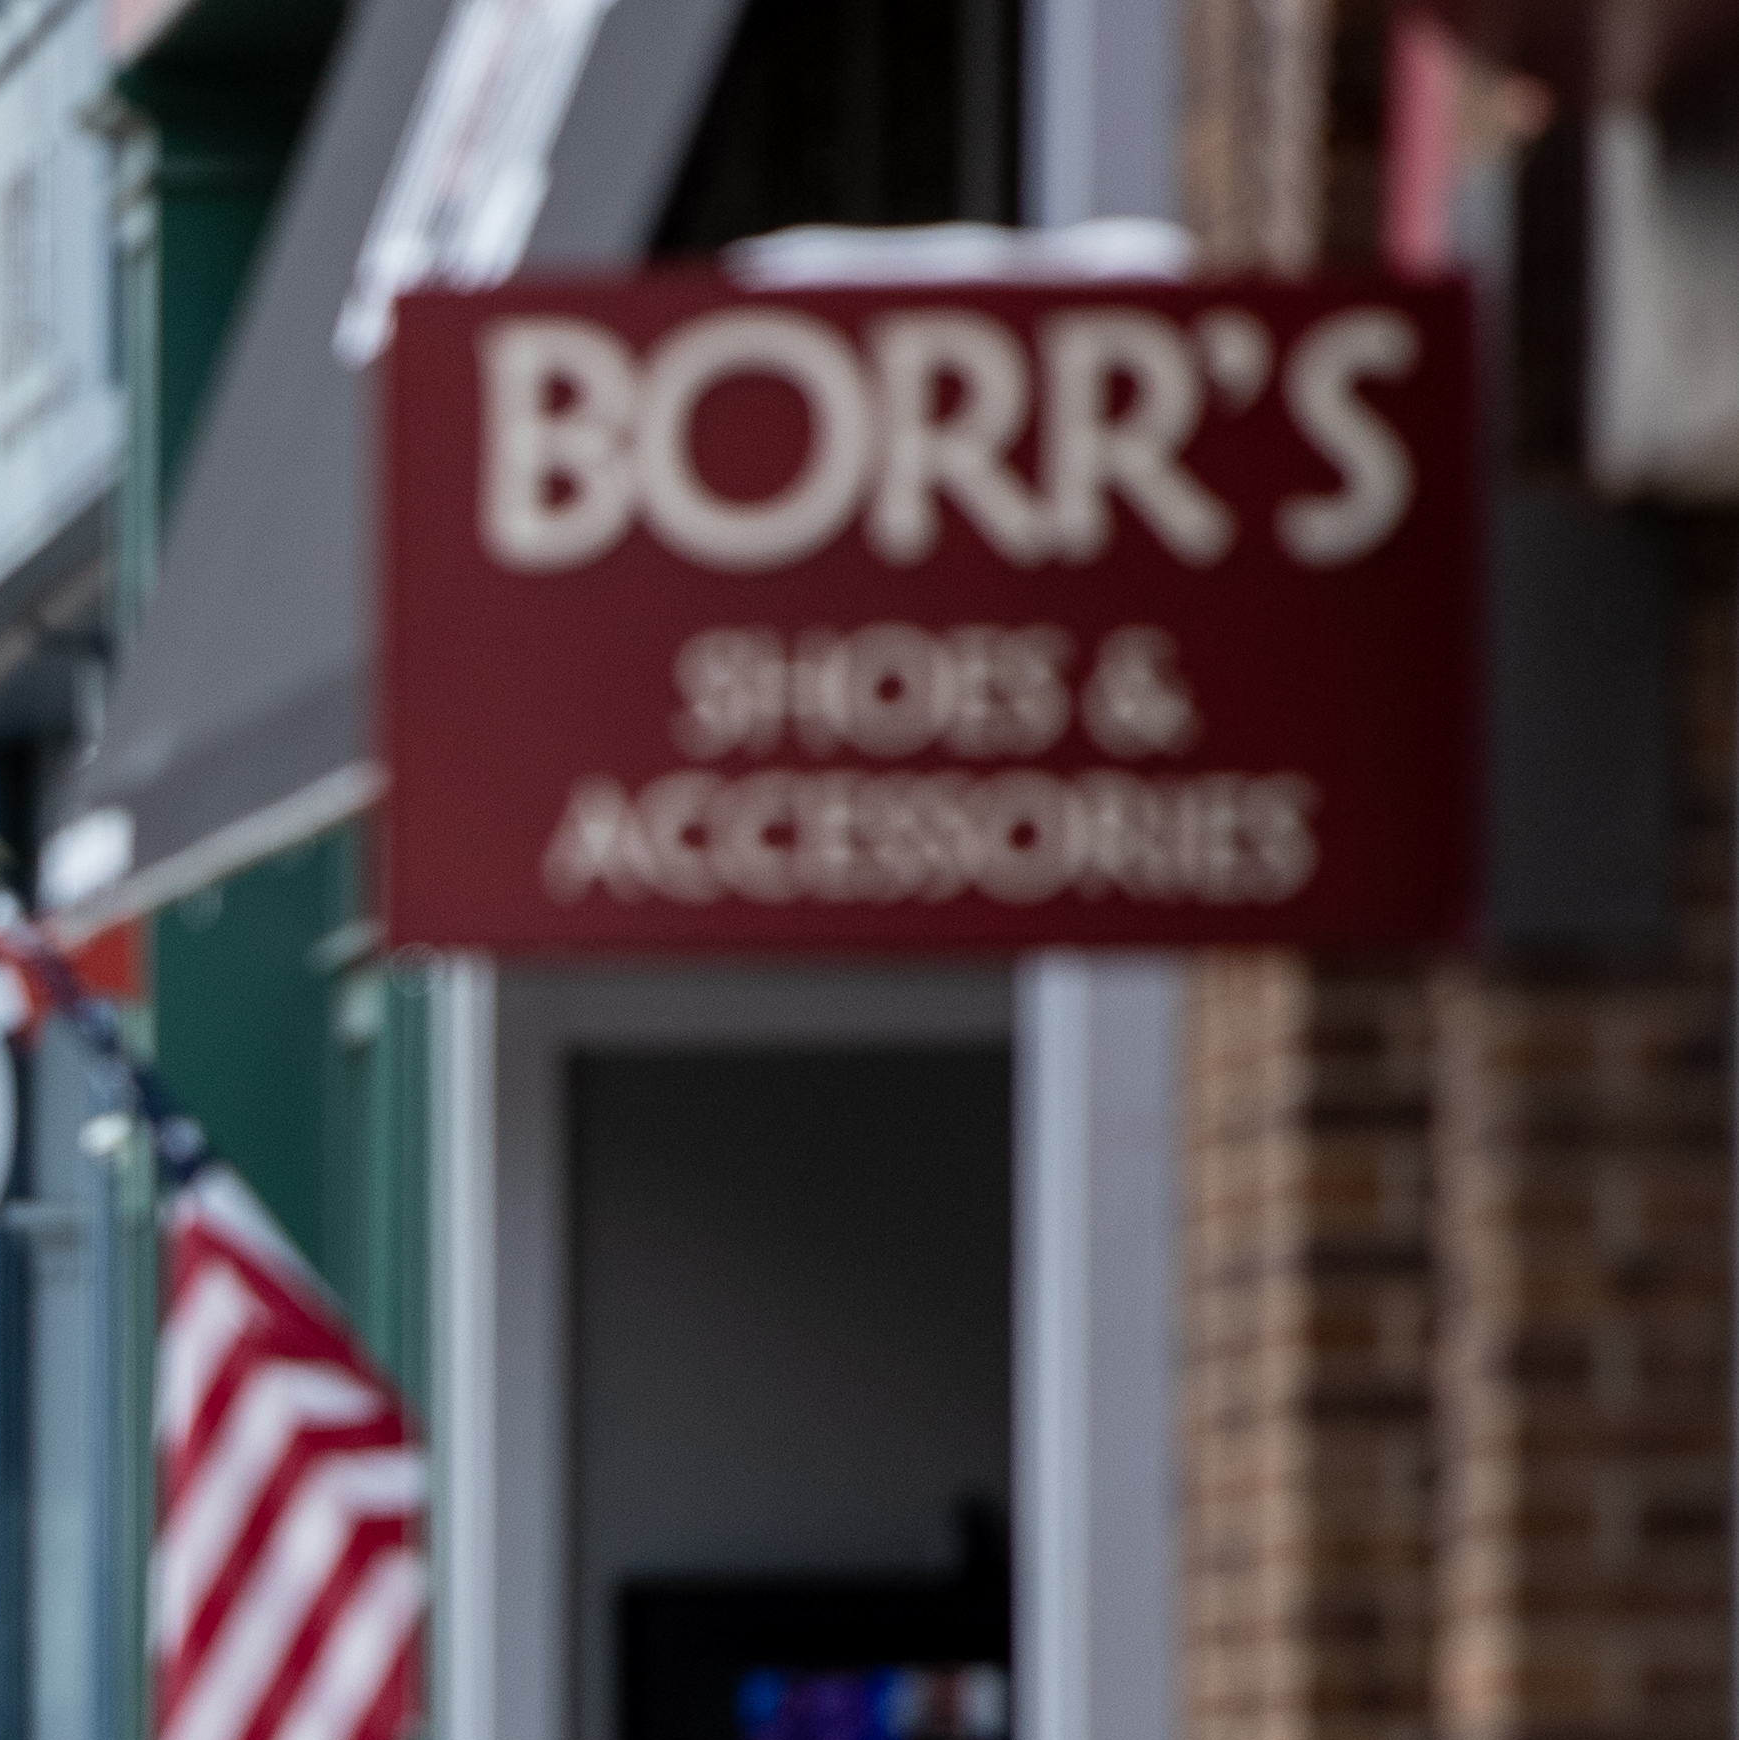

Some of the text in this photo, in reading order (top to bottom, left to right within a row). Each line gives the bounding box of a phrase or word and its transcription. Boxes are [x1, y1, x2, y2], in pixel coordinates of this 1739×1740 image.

[479, 307, 1420, 571] BORR'S
[673, 624, 1199, 757] SHOES &
[543, 771, 1317, 904] ACCESSORIES
